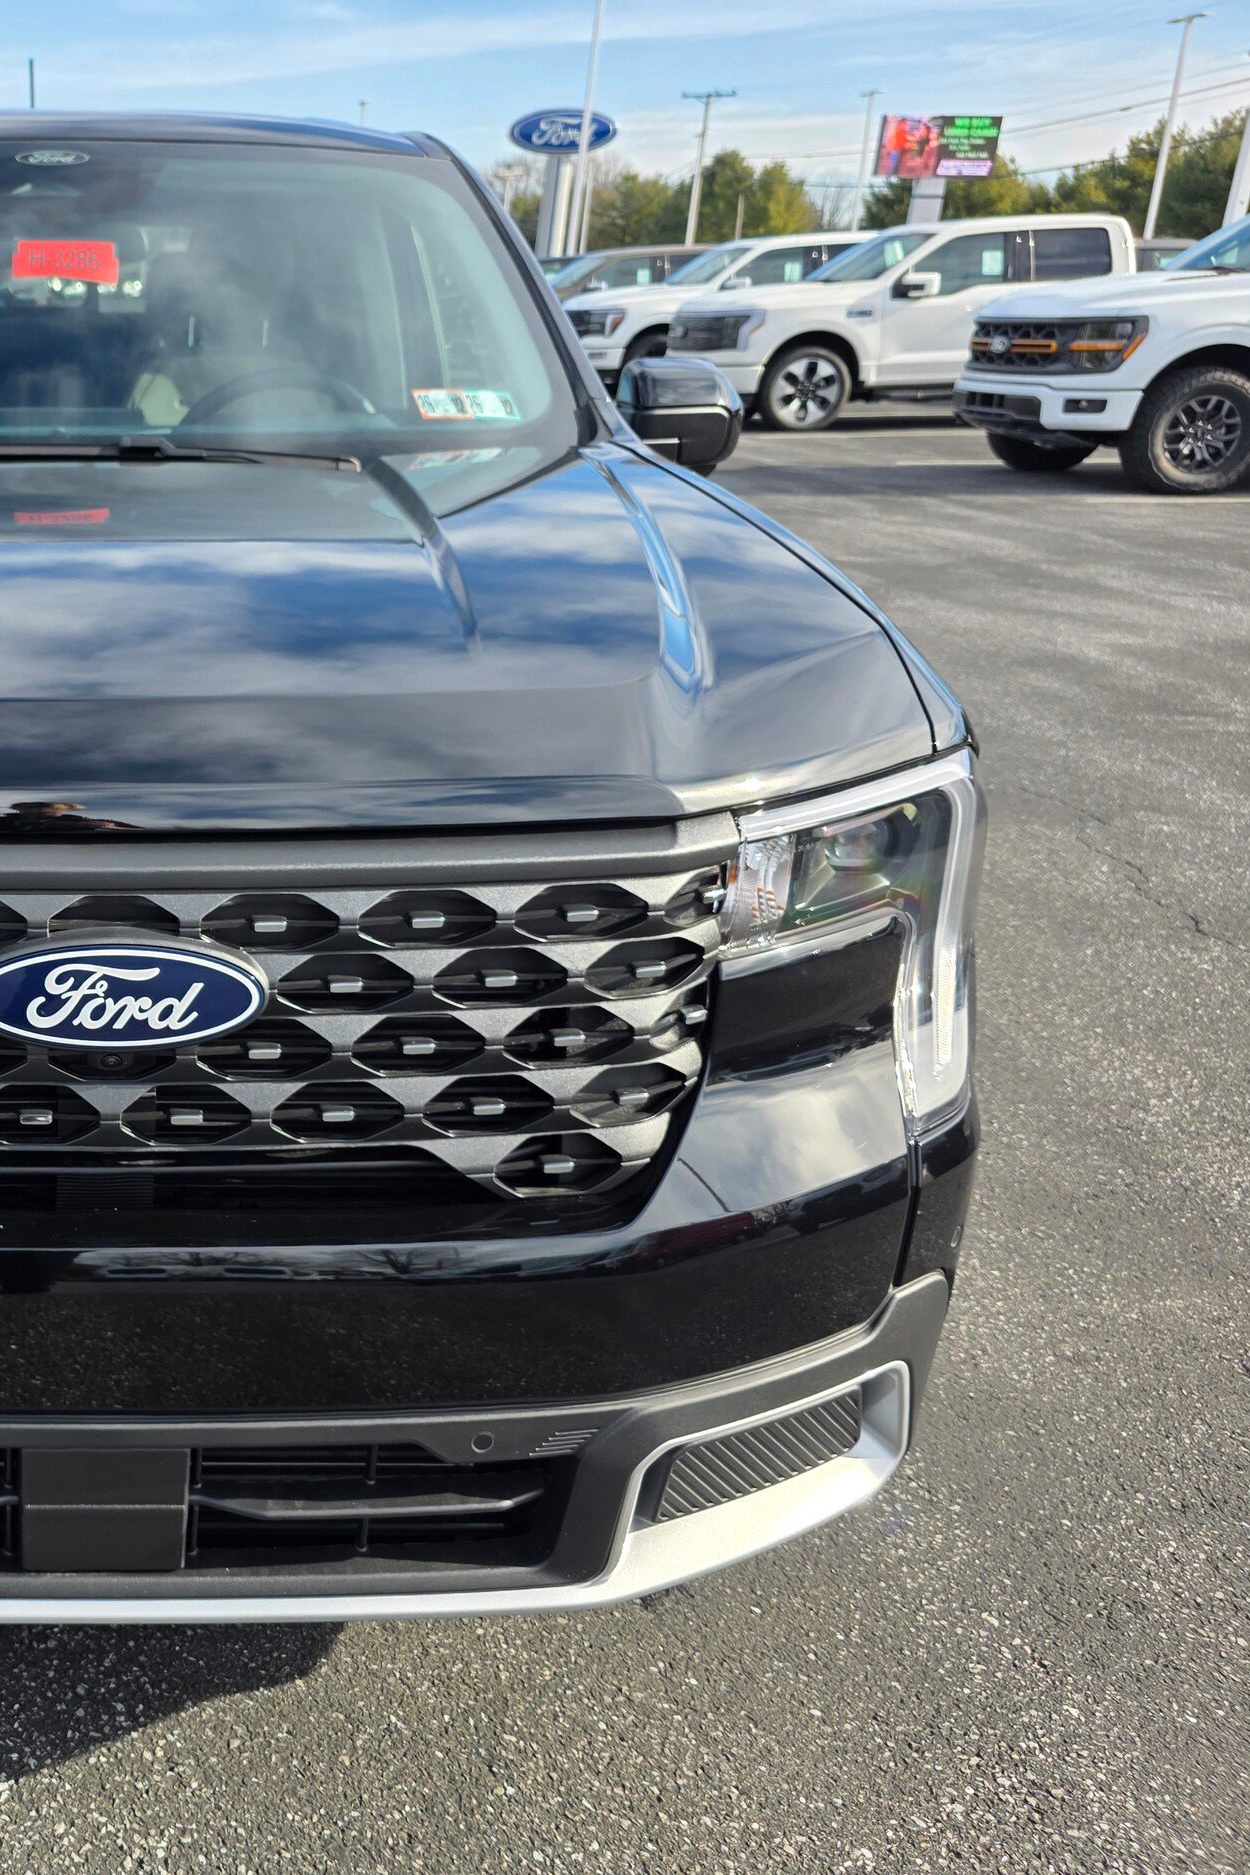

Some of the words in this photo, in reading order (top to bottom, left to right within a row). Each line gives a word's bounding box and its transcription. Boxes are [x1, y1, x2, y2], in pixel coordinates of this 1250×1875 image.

[28, 150, 78, 163] Ford
[29, 249, 100, 272] H-3286
[26, 963, 205, 1030] Ford
